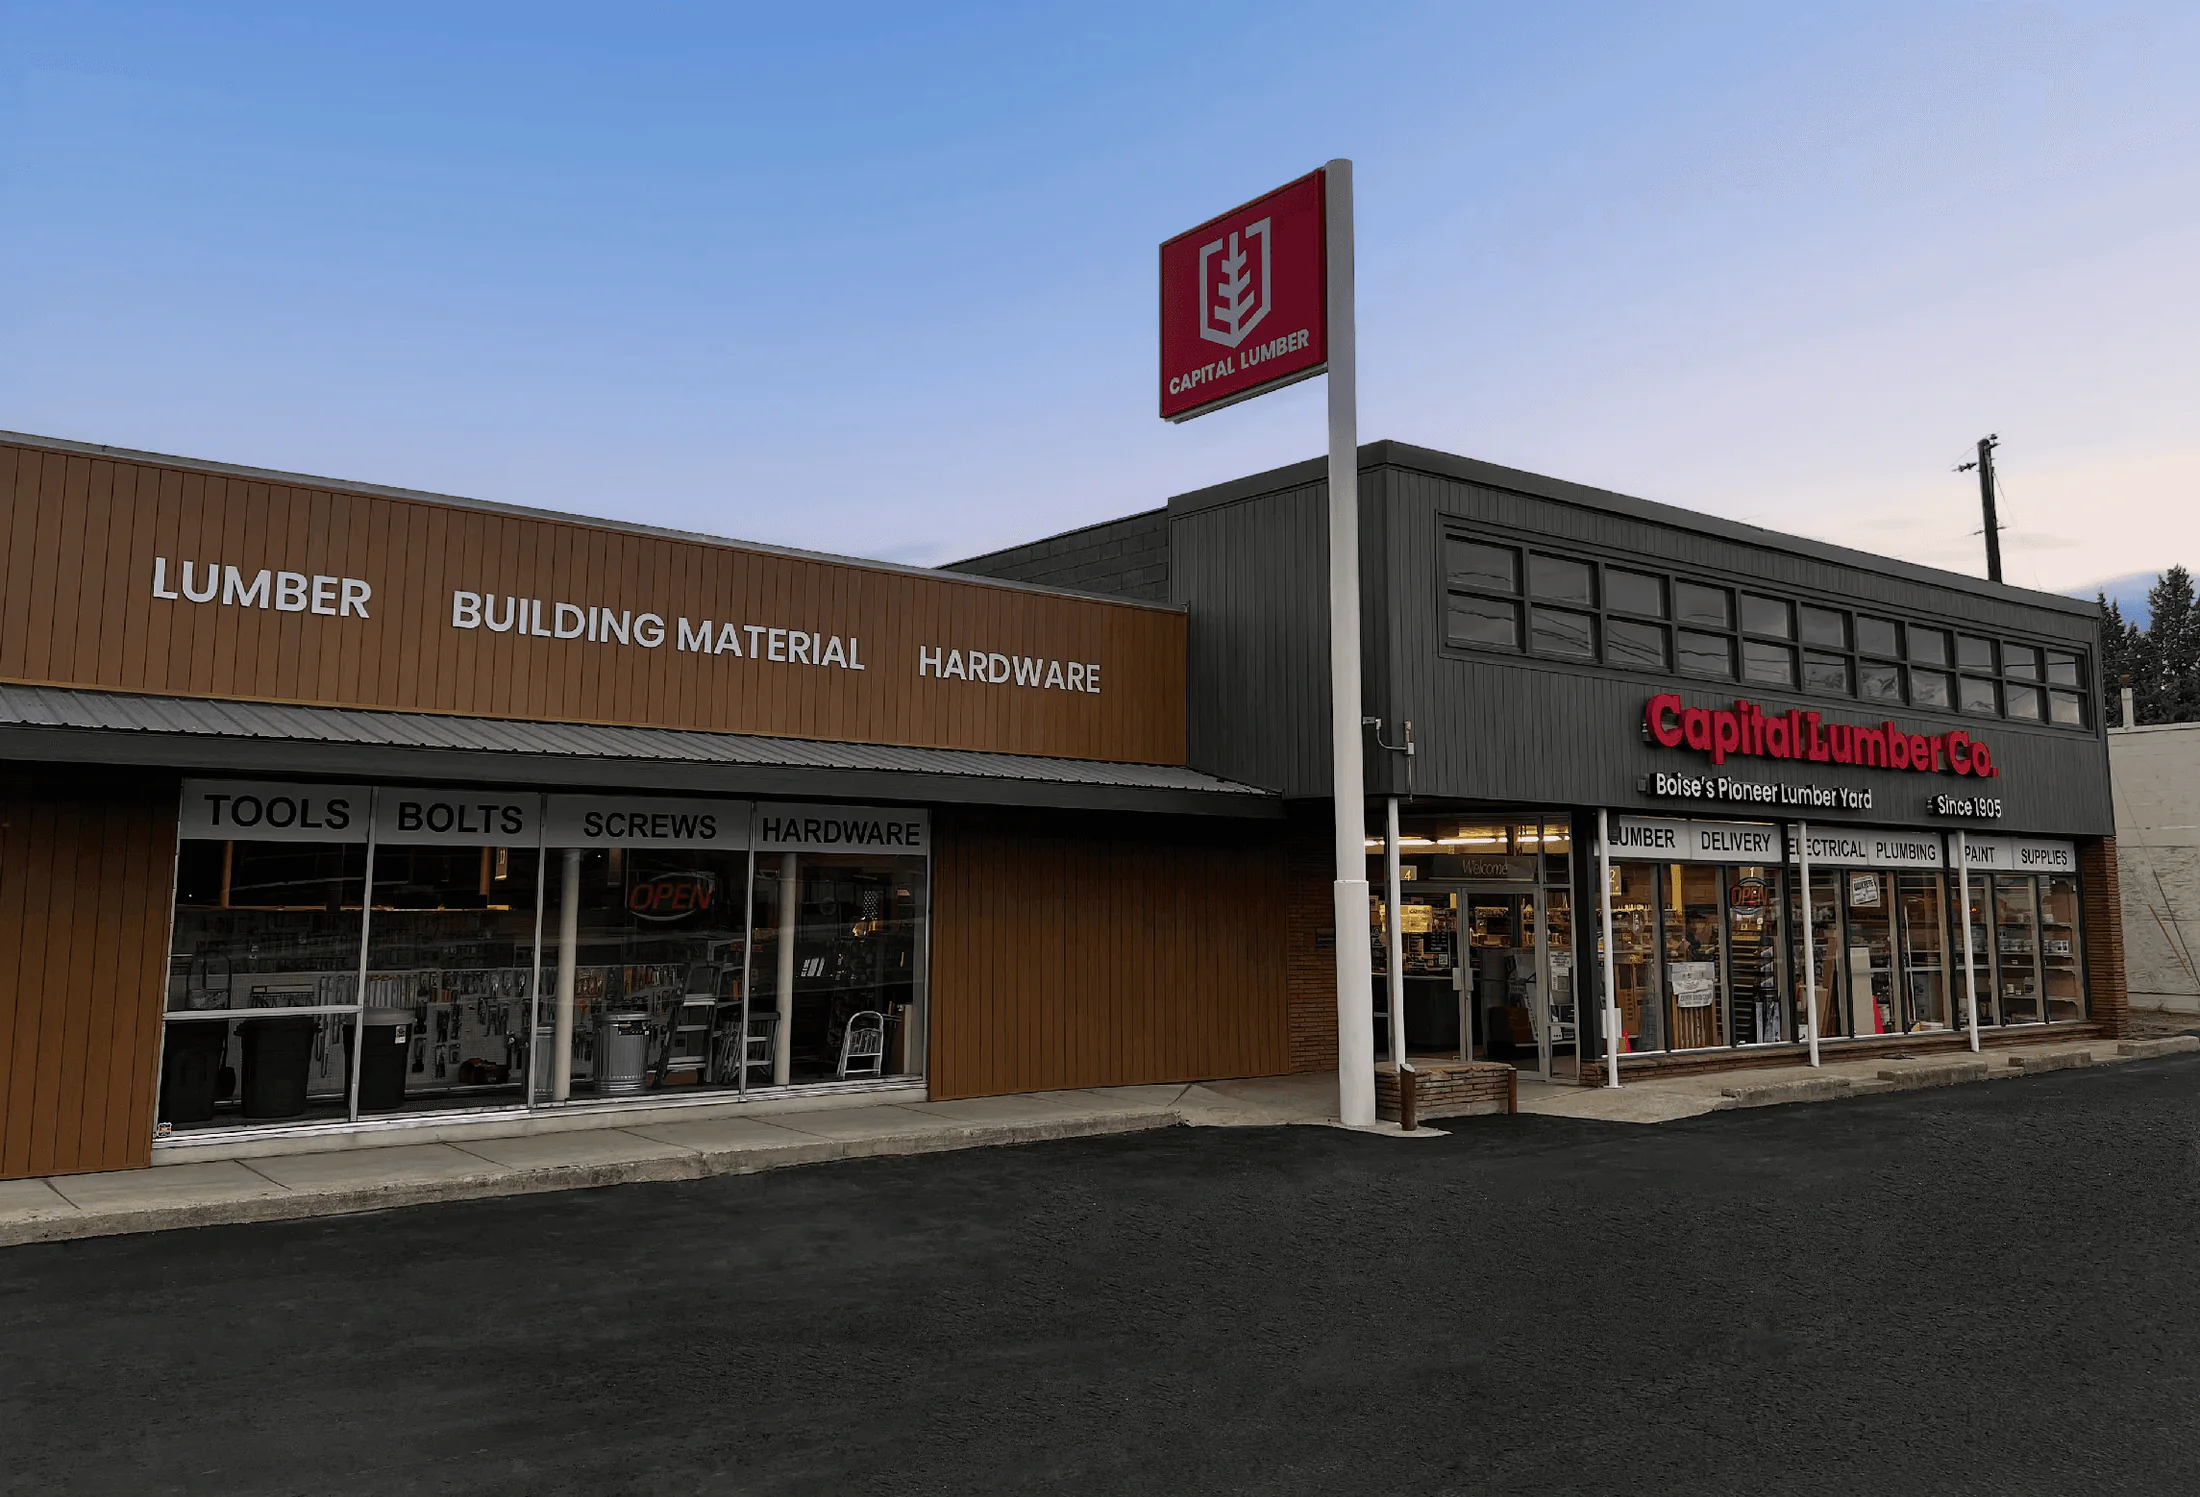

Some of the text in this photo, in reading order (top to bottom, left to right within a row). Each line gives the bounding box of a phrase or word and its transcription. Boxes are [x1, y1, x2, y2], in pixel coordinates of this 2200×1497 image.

[1169, 328, 1310, 395] CAPITAL LUMBER
[153, 557, 372, 619] LUMBER
[452, 590, 865, 671] BUILDING MATERIAL
[919, 645, 1100, 694] HARDWARE
[1646, 693, 1999, 778] Capital Lumber Co.
[1656, 772, 1873, 809] Boise's Pioneer Lumber Yard
[205, 794, 350, 829] TOOLS
[397, 802, 523, 834] BOLTS
[1937, 794, 2002, 818] Since 1905
[583, 812, 717, 840] SCREWS
[761, 817, 921, 847] HARDWARE
[1610, 826, 1676, 848] UMBER
[1701, 831, 1771, 852] DELIVERY
[1876, 841, 1936, 861] PLUMBING
[1965, 845, 1995, 863] PAINT
[1462, 858, 1508, 875] Welcome
[2021, 848, 2067, 866] SUPPLIES
[1404, 869, 1411, 882] 4
[630, 883, 713, 910] OPEN
[1731, 877, 1768, 905] OPEN
